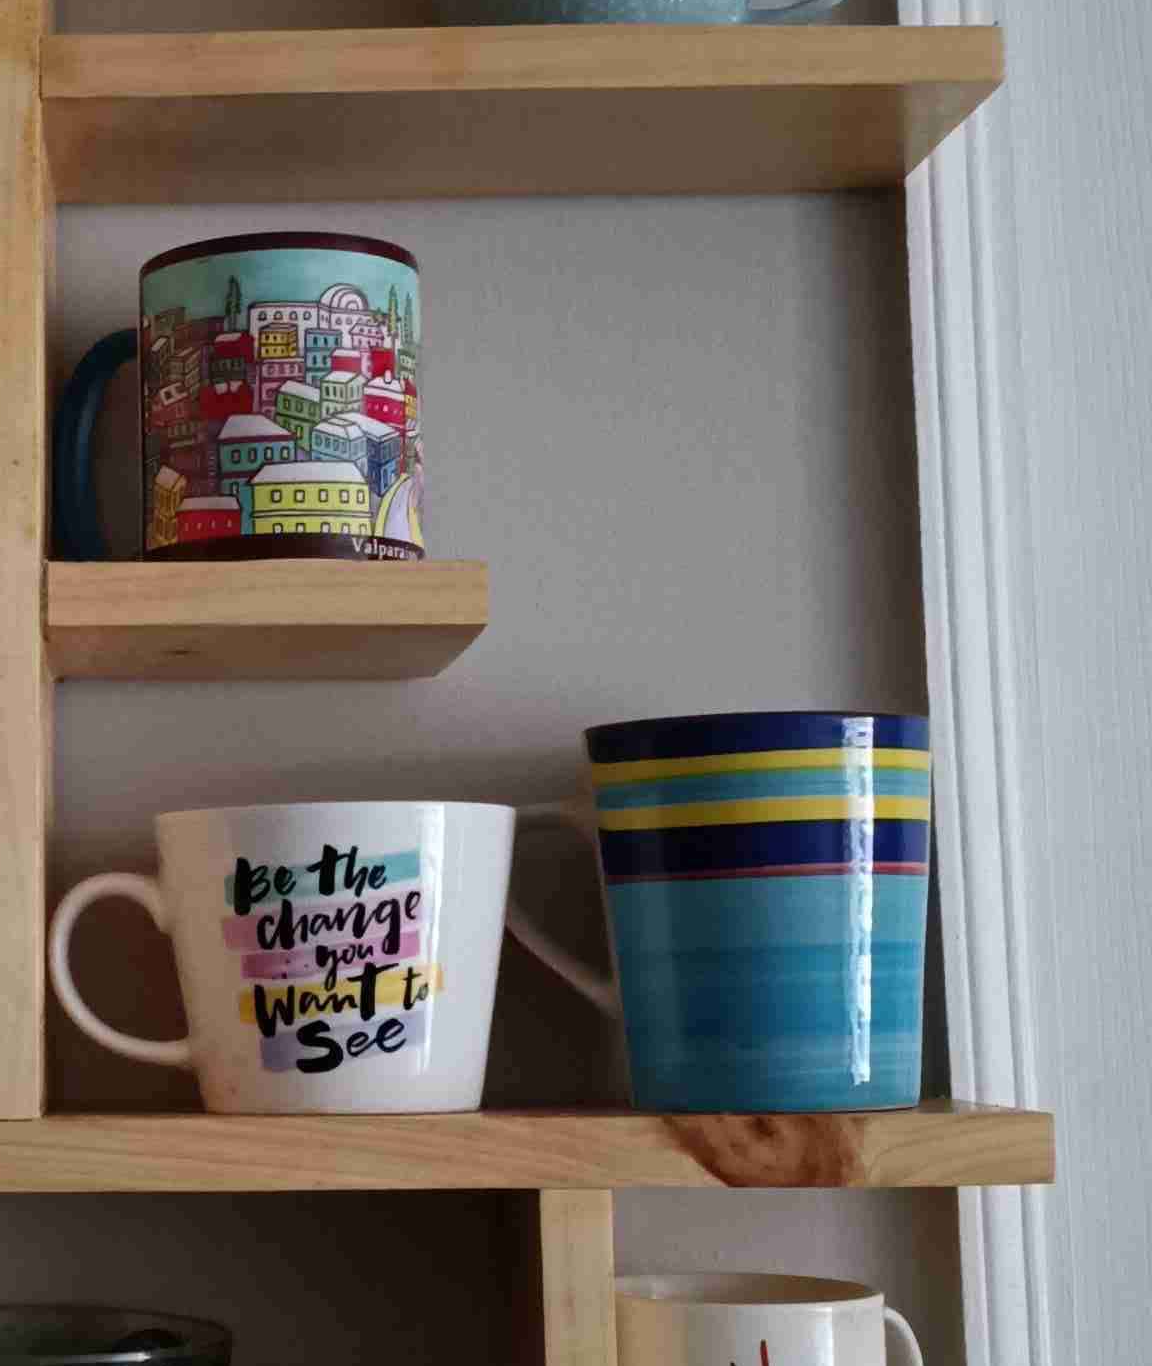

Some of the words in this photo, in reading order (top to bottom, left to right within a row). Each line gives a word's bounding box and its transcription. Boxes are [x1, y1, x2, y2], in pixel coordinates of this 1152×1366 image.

[234, 857, 297, 916] Be
[306, 844, 387, 897] the
[257, 891, 421, 955] change
[315, 945, 374, 991] you
[403, 966, 429, 1011] to
[296, 1018, 407, 1074] See
